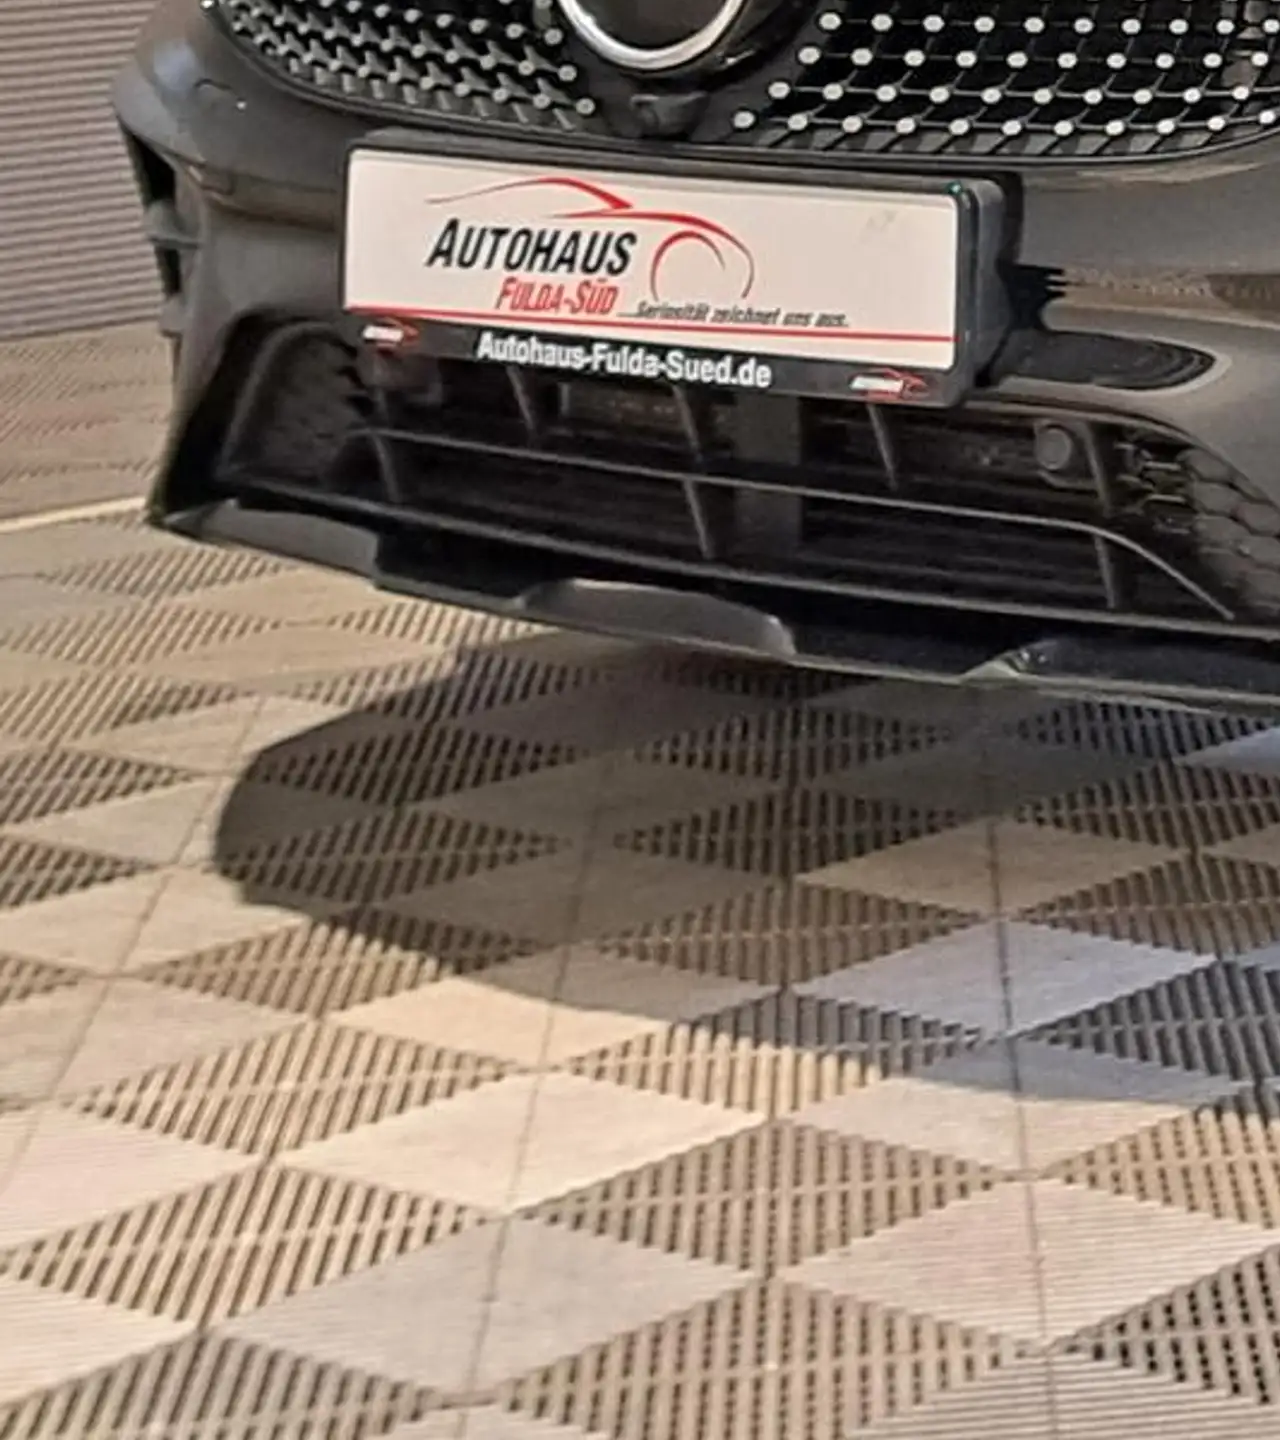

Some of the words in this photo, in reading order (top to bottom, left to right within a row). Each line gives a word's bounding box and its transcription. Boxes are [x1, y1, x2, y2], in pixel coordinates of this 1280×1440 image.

[425, 218, 637, 275] AUTOHAUS
[495, 276, 620, 315] FULDA-SÜD
[477, 331, 773, 388] Autohaus-Fulda-Sued.de
